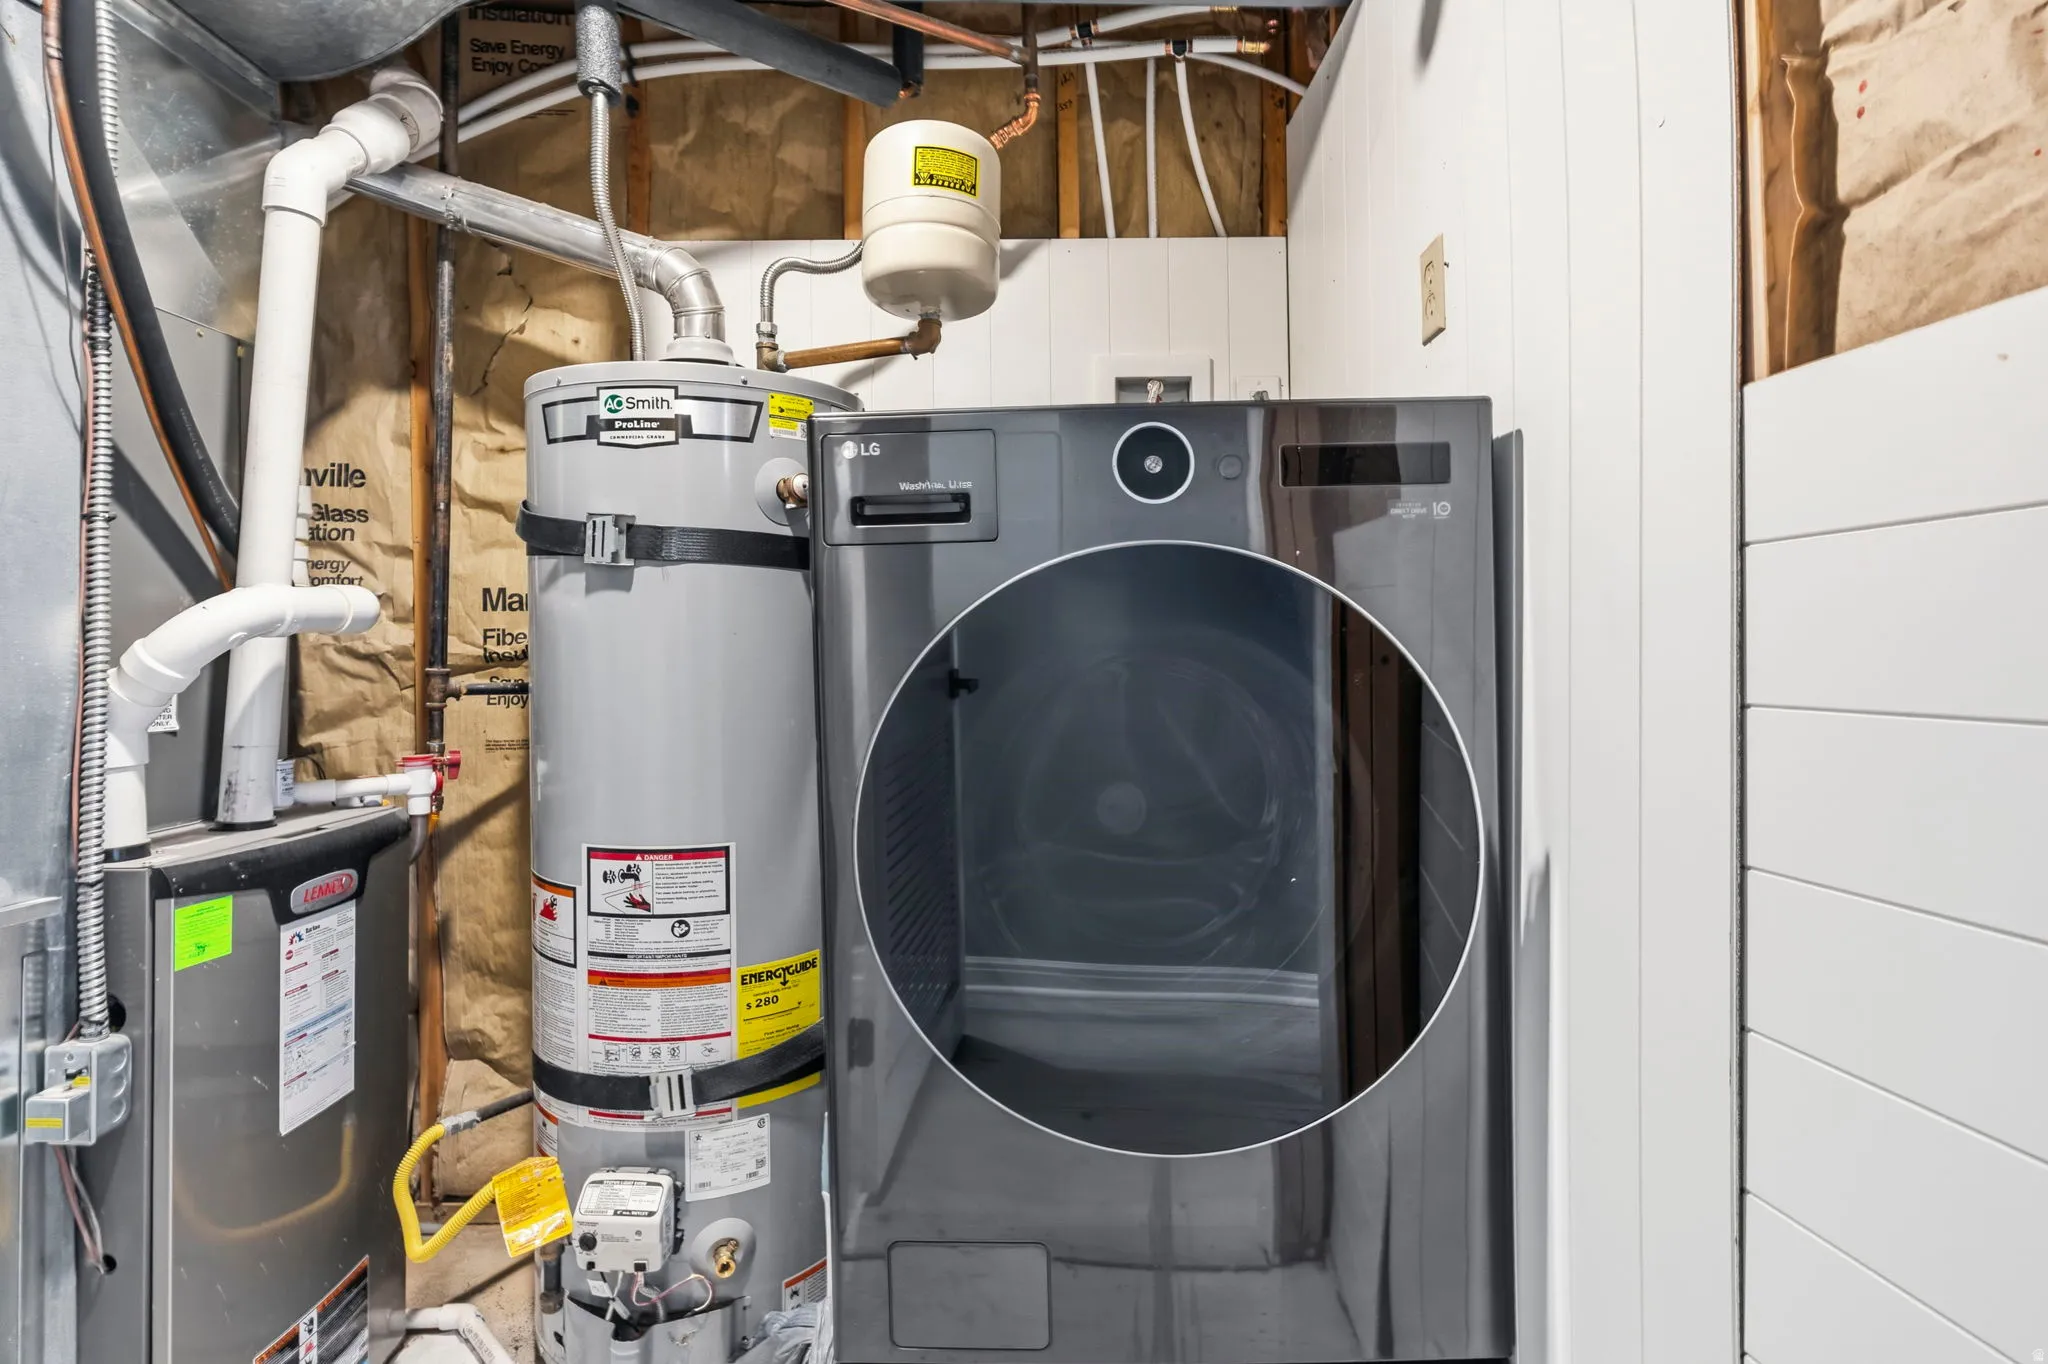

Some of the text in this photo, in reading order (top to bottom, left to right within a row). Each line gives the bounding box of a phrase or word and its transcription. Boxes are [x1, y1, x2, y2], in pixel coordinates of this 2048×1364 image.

[470, 38, 565, 59] Save Energy
[472, 57, 514, 76] Enjoy
[614, 420, 660, 429] ProLine
[861, 442, 881, 456] LG
[311, 502, 370, 523] Glass
[309, 573, 364, 588] omfort
[482, 587, 529, 612] Ma
[483, 628, 528, 646] Fibe
[487, 694, 529, 709] Enjoy
[644, 853, 674, 861] DANGER
[740, 957, 819, 986] ENERGYGUIDE
[755, 995, 779, 1009] 280
